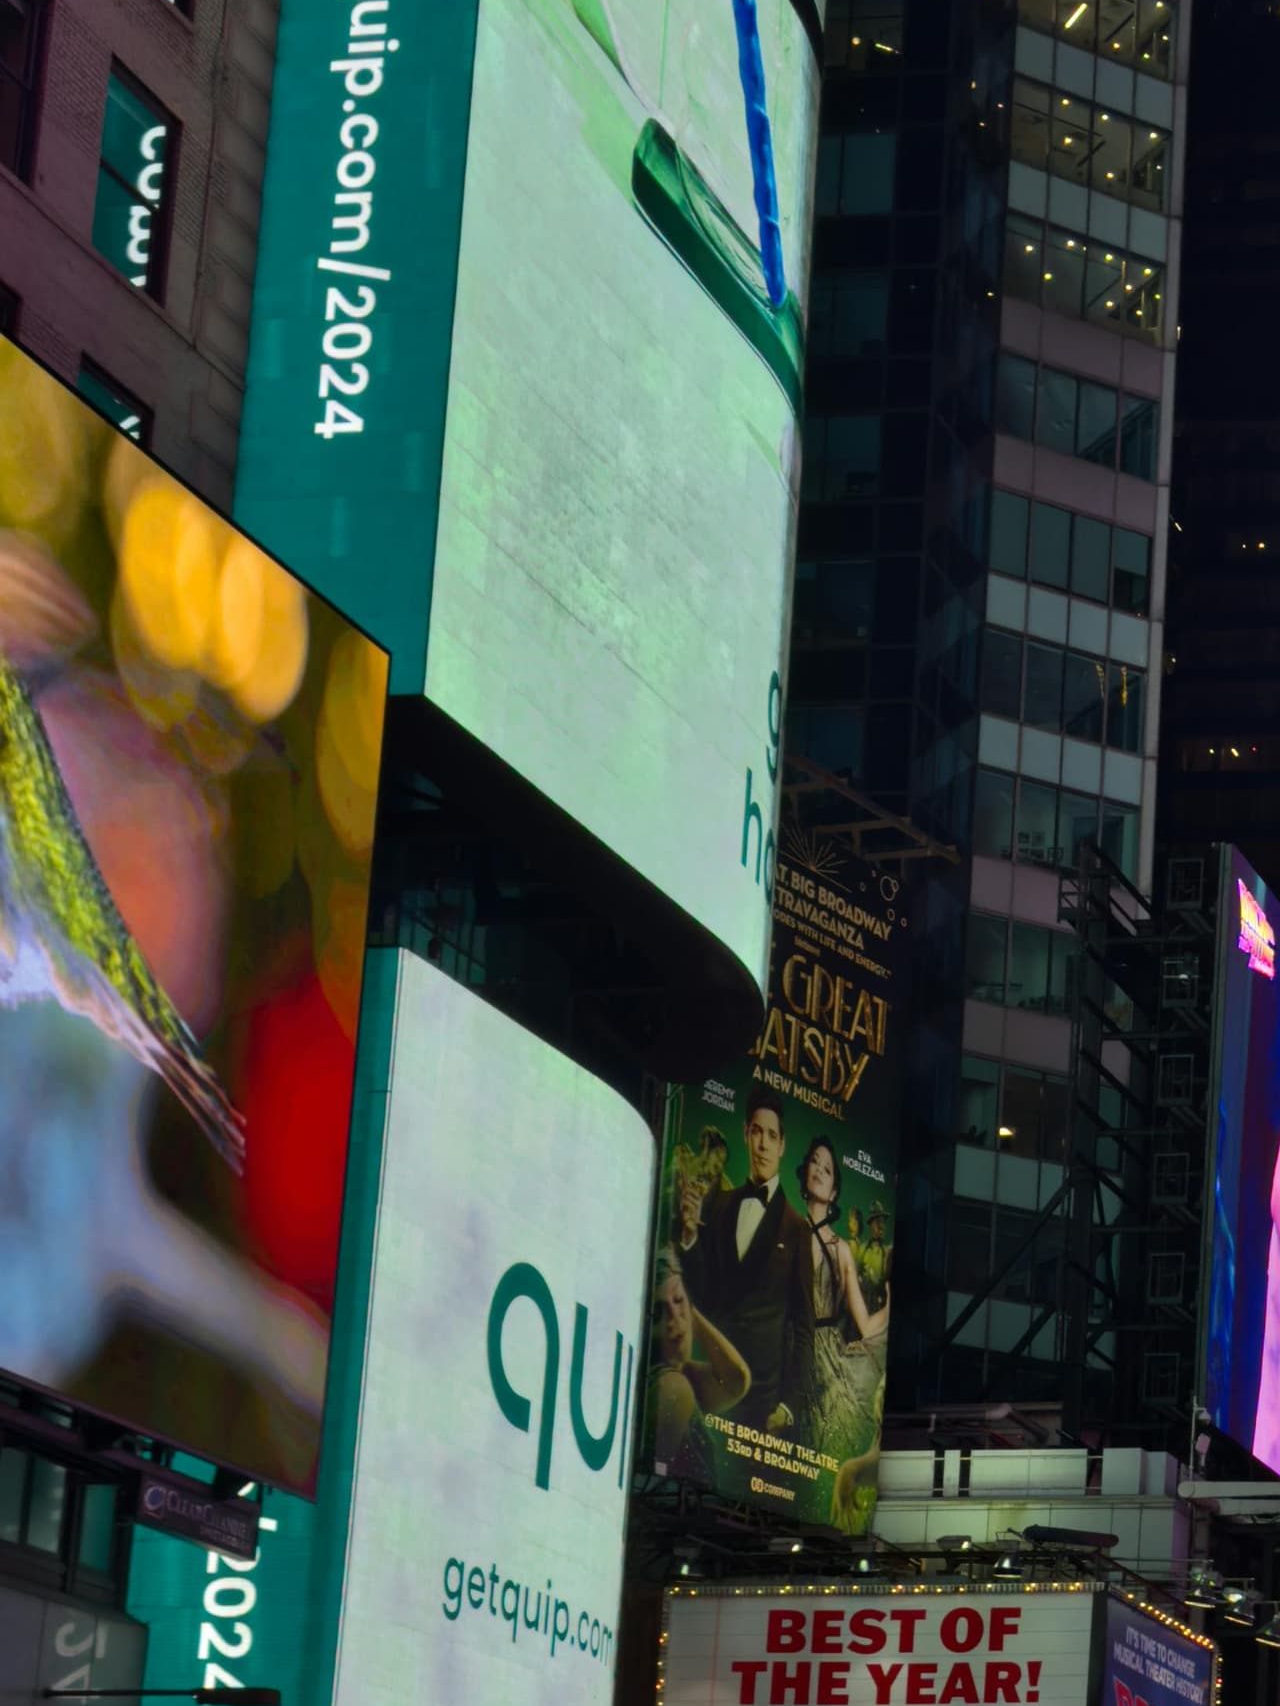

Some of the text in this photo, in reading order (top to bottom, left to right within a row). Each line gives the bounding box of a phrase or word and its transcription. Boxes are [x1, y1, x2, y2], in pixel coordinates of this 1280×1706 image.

[818, 881, 892, 942] BROADWAY
[782, 953, 888, 1057] GREAT
[736, 1424, 794, 1455] BROADWAY
[796, 1444, 840, 1473] THEATRE
[763, 1451, 820, 1480] BROADWAY
[766, 1606, 1022, 1655] BEST OF
[731, 1660, 1043, 1706] THE YEAR!
